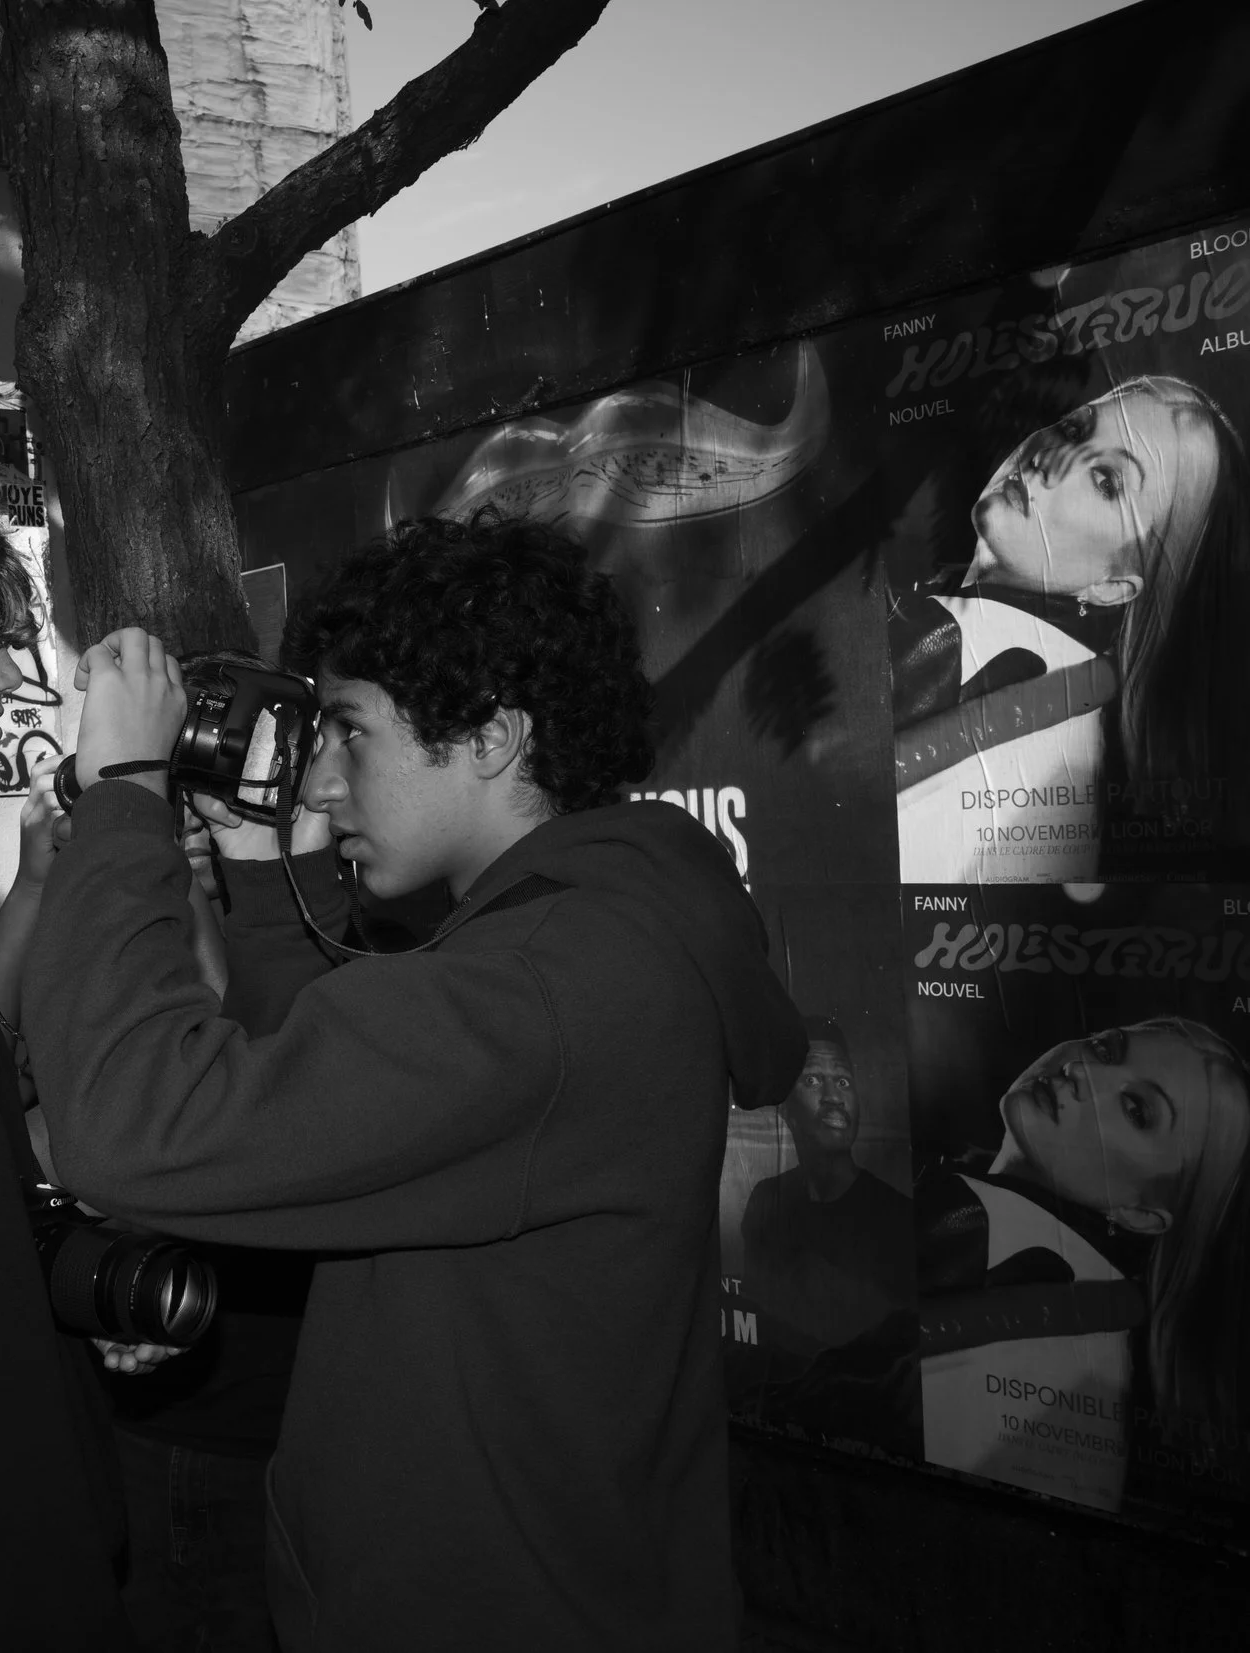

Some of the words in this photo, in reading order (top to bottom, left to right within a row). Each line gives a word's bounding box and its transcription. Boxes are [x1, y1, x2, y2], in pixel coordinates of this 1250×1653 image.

[883, 313, 936, 342] FANNY
[1190, 228, 1250, 260] BLOO
[888, 398, 955, 426] NOUVEL
[960, 785, 1096, 811] DISPONIBLE
[976, 827, 994, 844] 10
[1110, 820, 1158, 840] LION
[914, 896, 968, 912] FANNY
[918, 981, 985, 1000] NOUVEL
[985, 1373, 1123, 1424] DISPONIBLE
[1000, 1413, 1019, 1432] 10
